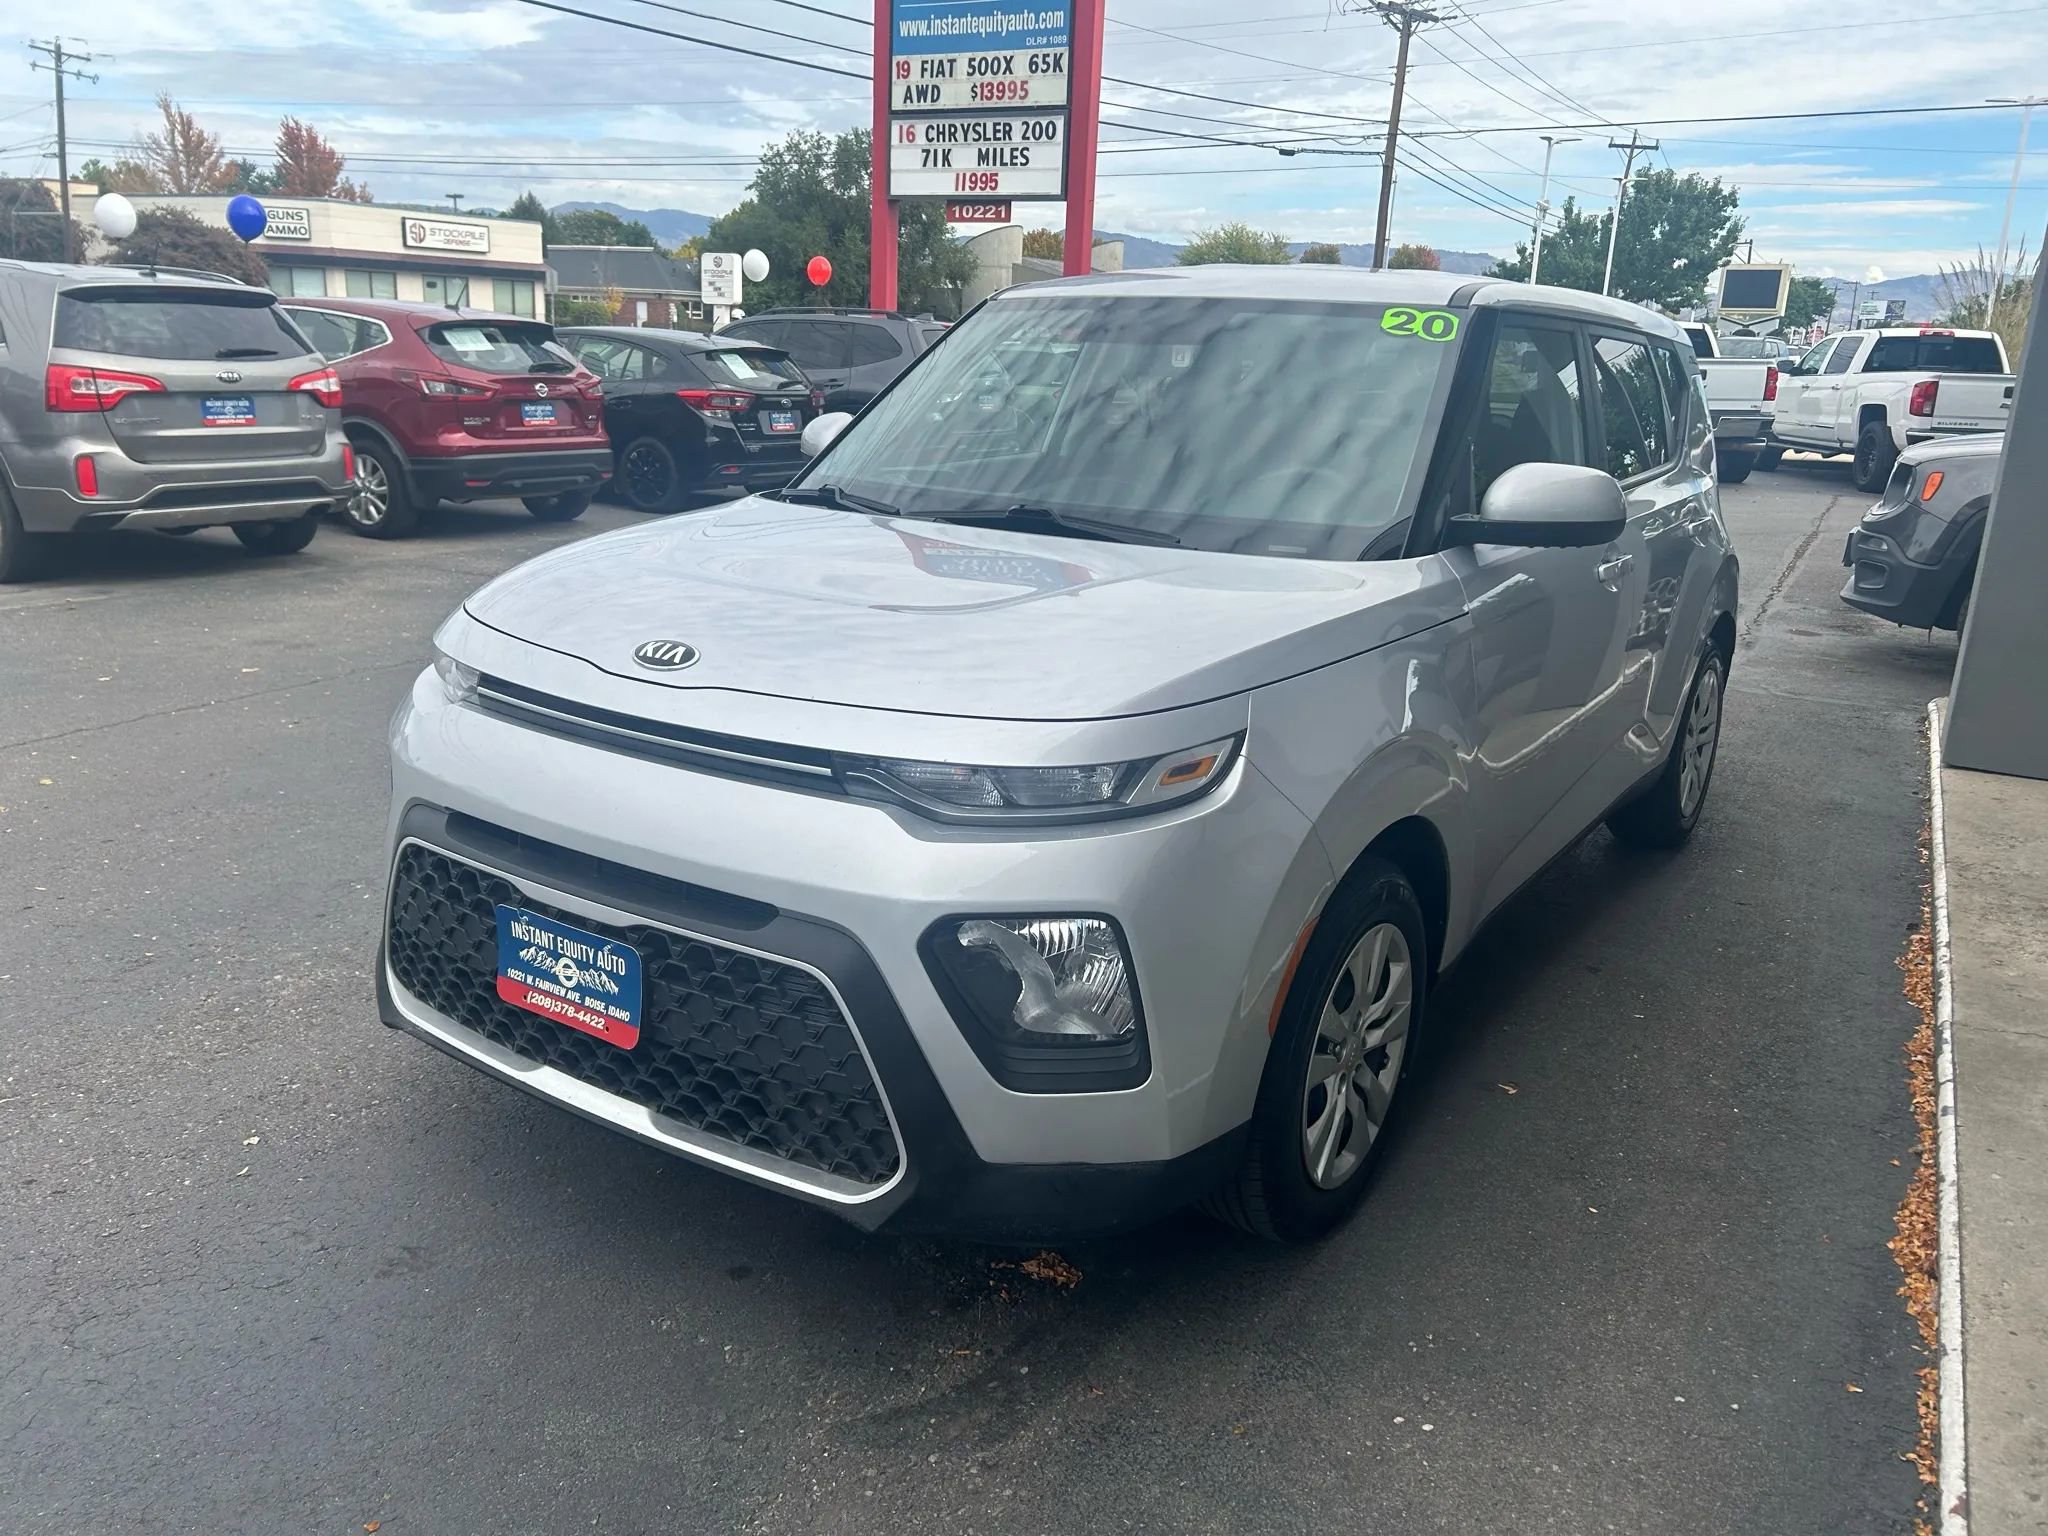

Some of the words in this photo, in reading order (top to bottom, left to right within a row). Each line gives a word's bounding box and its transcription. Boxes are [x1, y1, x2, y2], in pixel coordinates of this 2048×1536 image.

[899, 10, 1064, 38] www.instantequityauto.com
[1026, 36, 1047, 46] DLR#
[1049, 35, 1067, 45] 1089
[895, 60, 911, 79] 19
[920, 58, 957, 79] FIAT
[966, 55, 1014, 77] 500X
[1028, 52, 1064, 74] 65K
[903, 84, 941, 104] AWD
[971, 80, 1029, 101] $13995
[899, 124, 916, 143] 16
[925, 122, 1013, 143] CHRYSLER
[1021, 120, 1057, 141] 200
[921, 148, 952, 168] 71K
[977, 147, 1030, 167] MILES
[955, 172, 999, 192] 11995
[267, 209, 304, 222] GUNS
[951, 205, 1006, 218] 10221
[266, 224, 308, 236] AMMO
[428, 227, 486, 241] STOCKPILE
[1384, 310, 1455, 340] 20
[638, 641, 687, 664] KIA
[510, 920, 555, 950] INSTANT
[557, 937, 594, 965] EQUITY
[597, 951, 626, 976] AUTO
[507, 968, 525, 982] 10221
[526, 974, 534, 985] W.
[535, 976, 566, 998] FAIRVIEW
[566, 989, 582, 1003] AVE.
[584, 996, 607, 1015] BOISE,
[608, 1005, 631, 1022] IDAHO
[526, 990, 606, 1030] (208)378-4422
